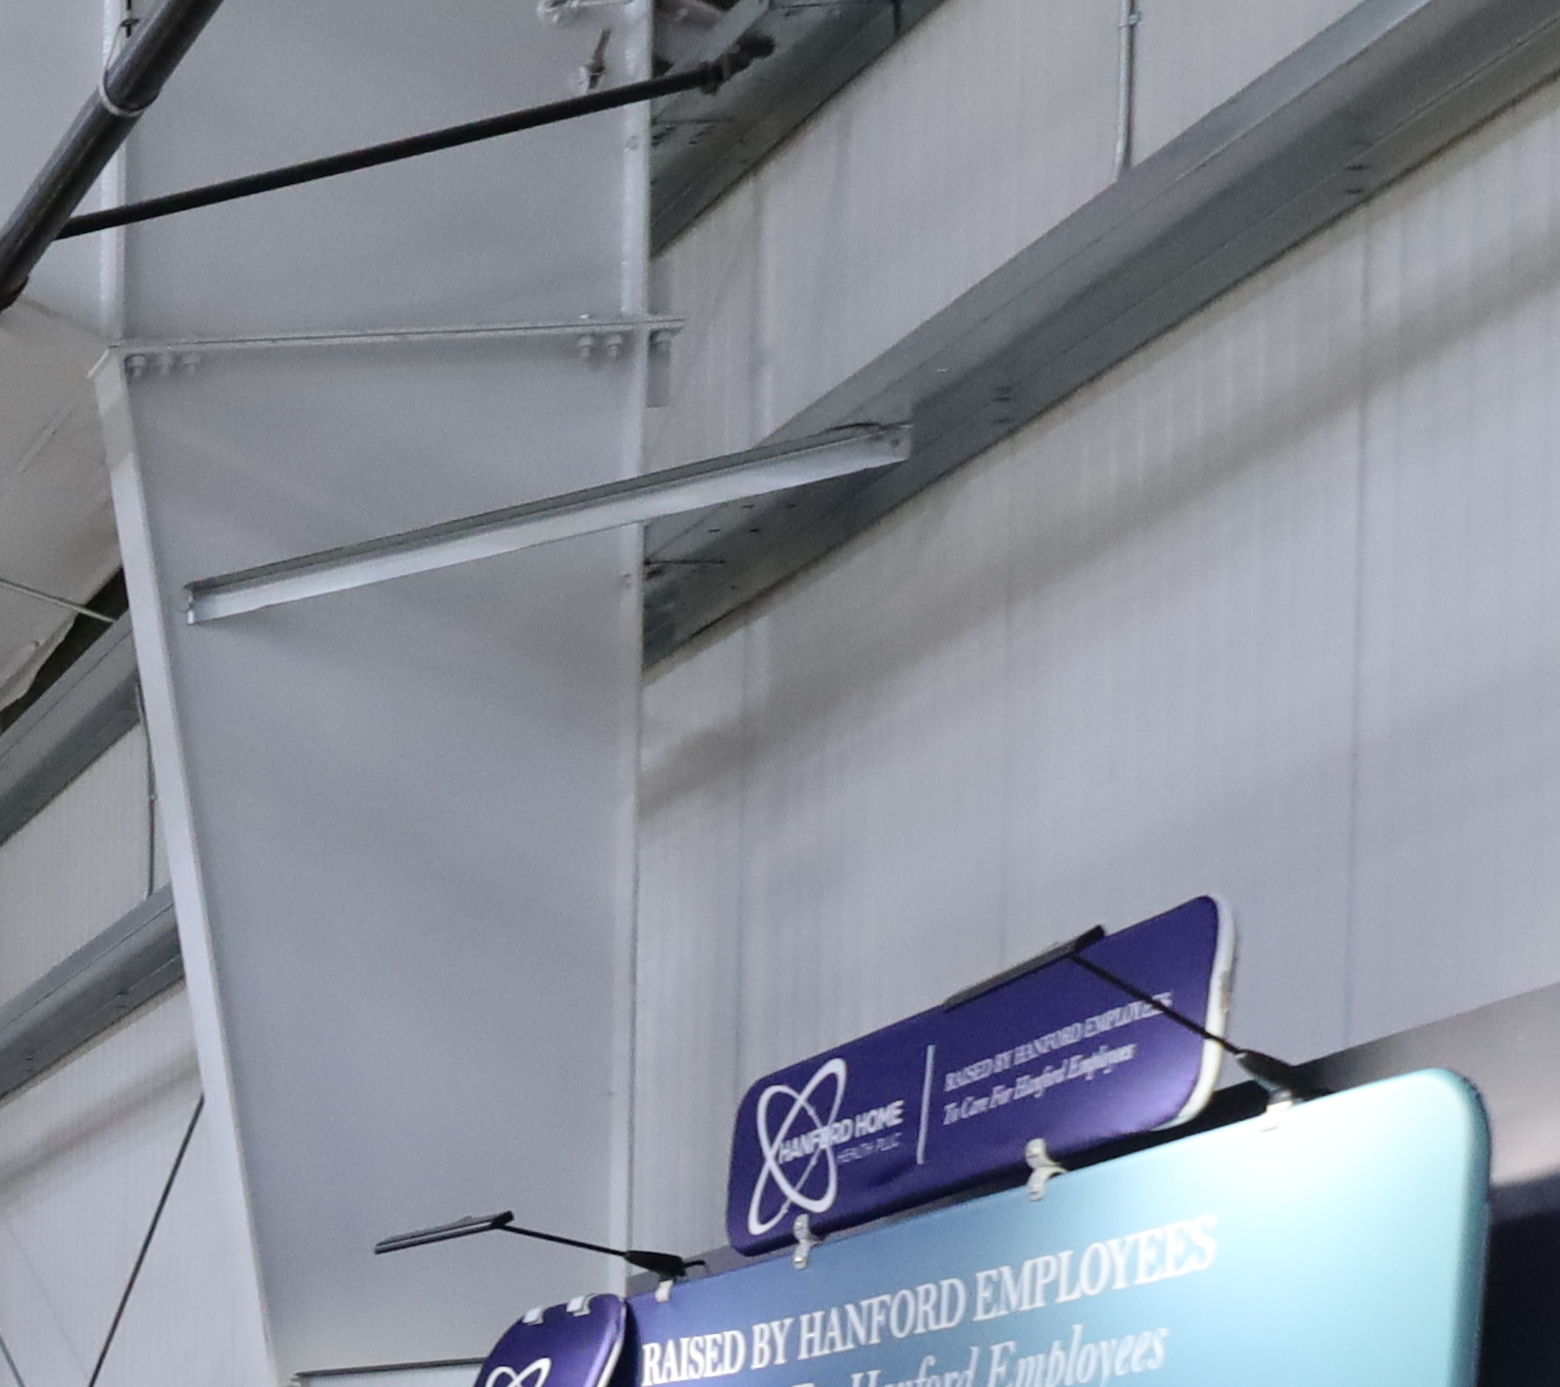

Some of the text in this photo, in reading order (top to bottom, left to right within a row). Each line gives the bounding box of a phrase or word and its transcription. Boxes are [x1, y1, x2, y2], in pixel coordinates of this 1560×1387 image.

[943, 1043, 1138, 1126] To Care For Hanford Employees
[944, 992, 1173, 1092] RAISED BY HANFORD EMPLOYEES
[855, 1100, 904, 1137] HOME
[641, 1213, 1217, 1387] RAISED BY HANFORD EMPLOYEES
